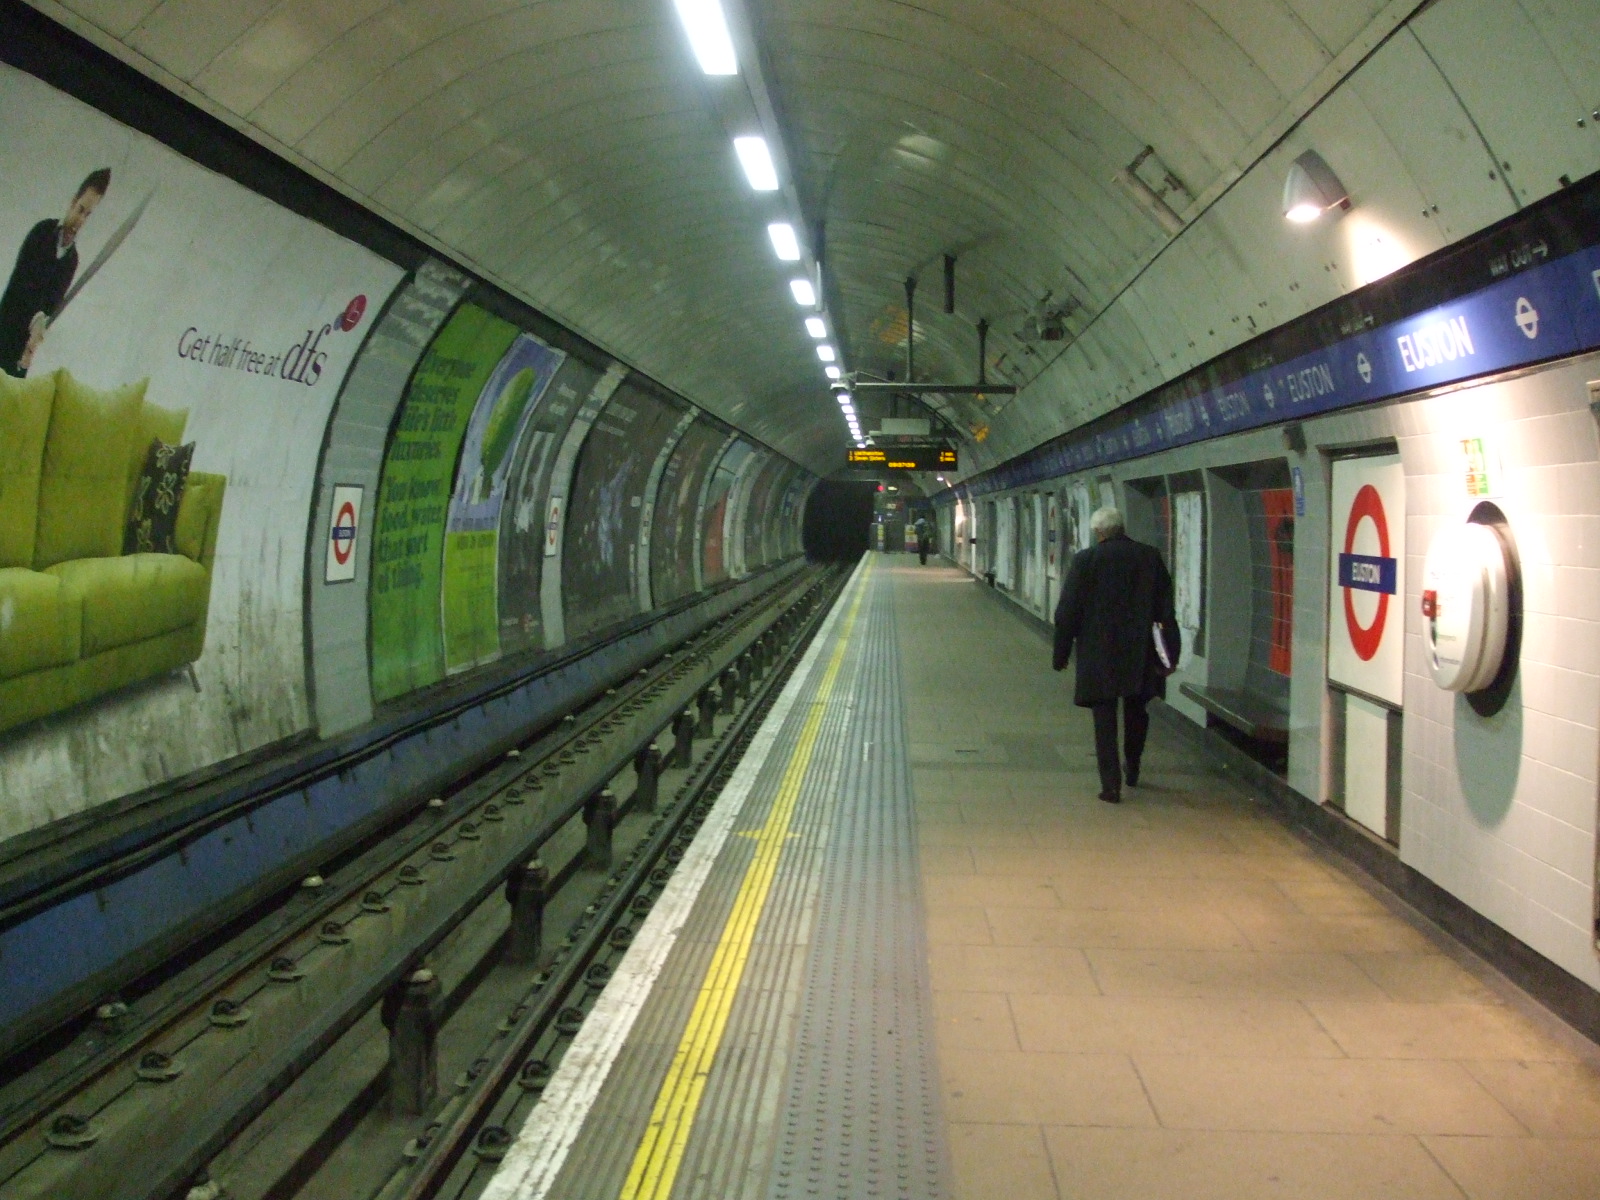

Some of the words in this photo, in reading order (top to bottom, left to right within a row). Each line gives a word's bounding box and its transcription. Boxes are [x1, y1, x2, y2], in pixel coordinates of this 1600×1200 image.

[178, 327, 210, 362] Get
[208, 333, 242, 368] half
[236, 341, 265, 373] free
[264, 352, 281, 377] at
[281, 323, 332, 386] dfs
[1397, 316, 1475, 372] EUSTON
[1287, 363, 1335, 402] EUSTON
[1352, 562, 1381, 584] EUSTON
